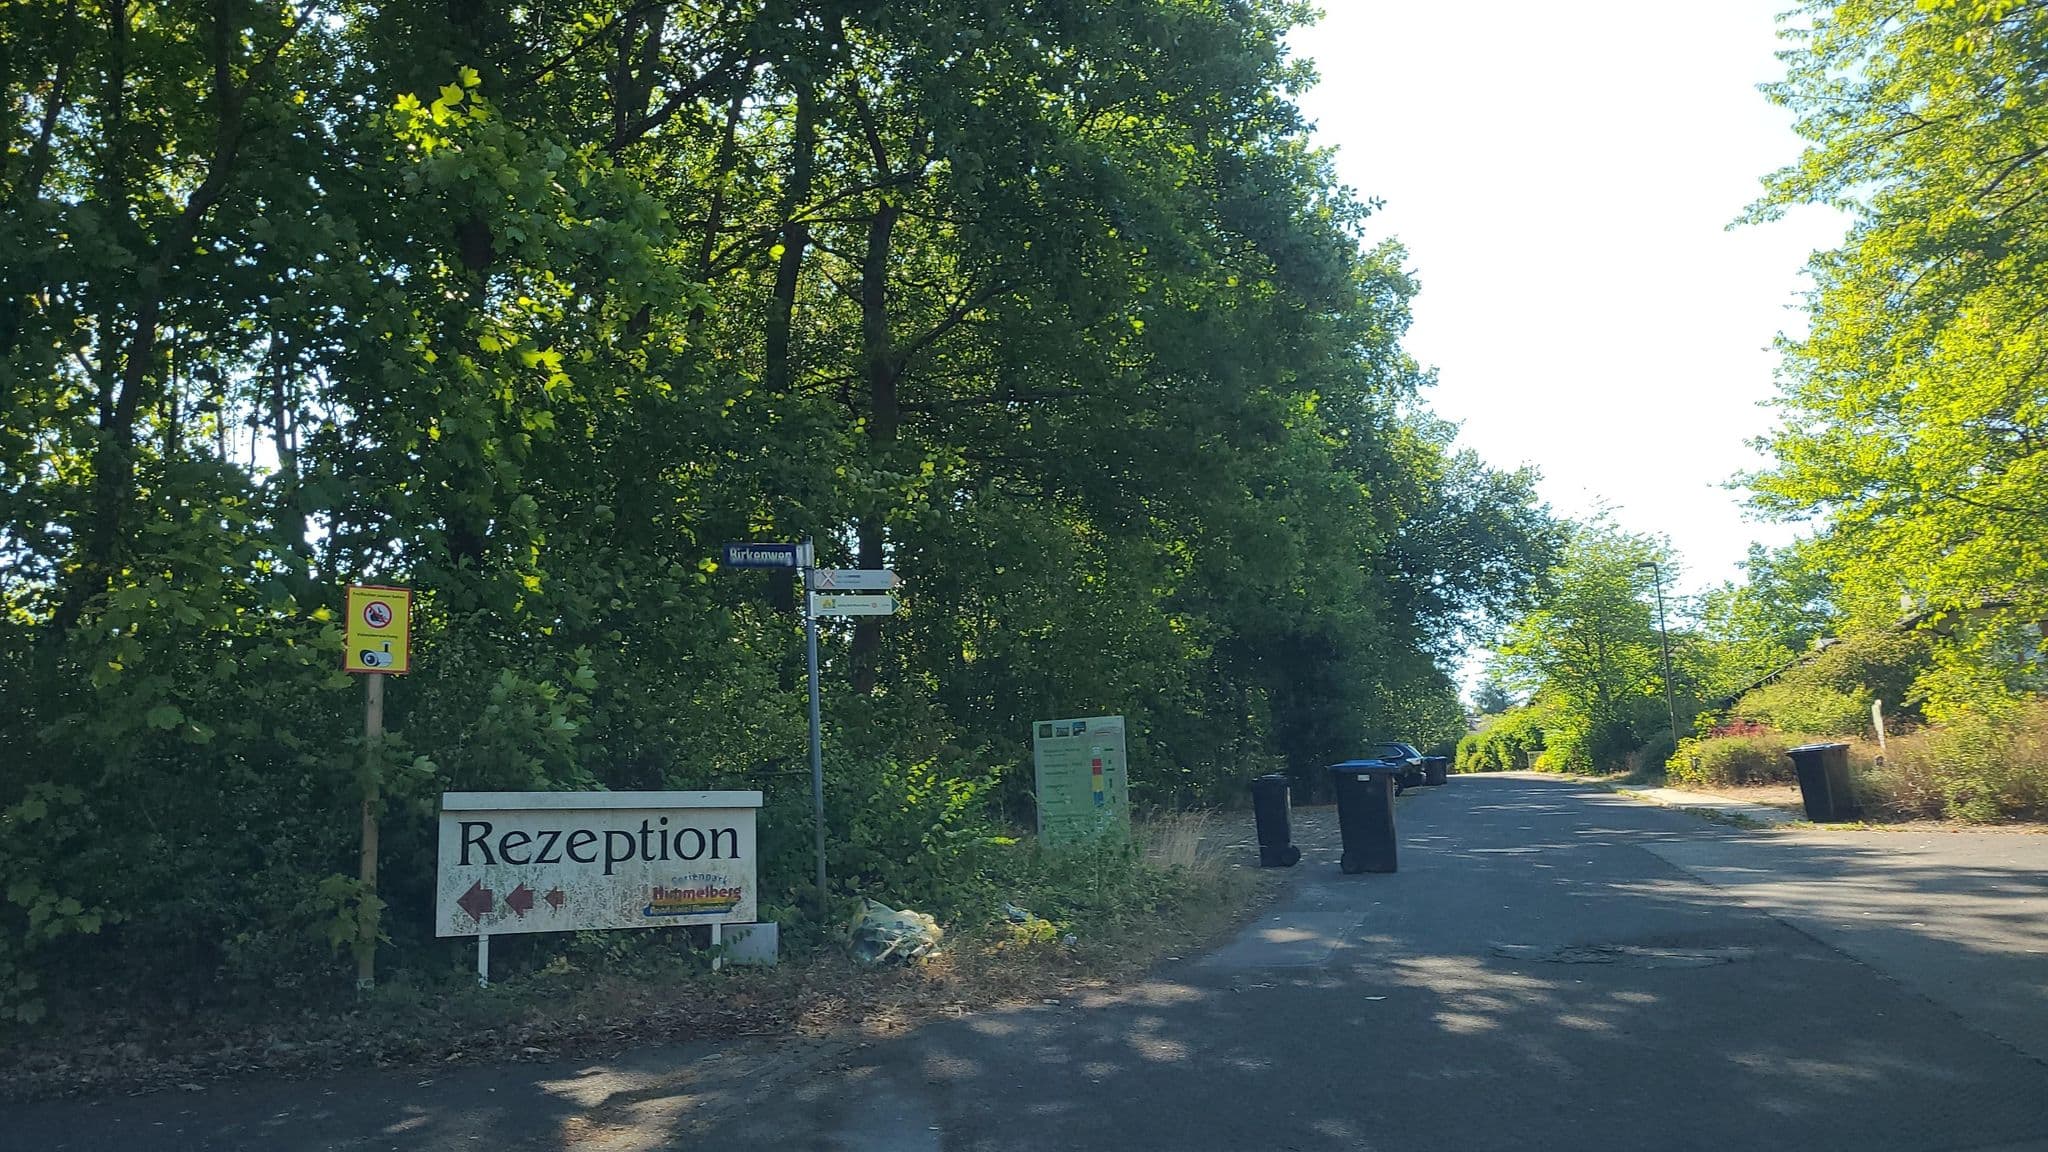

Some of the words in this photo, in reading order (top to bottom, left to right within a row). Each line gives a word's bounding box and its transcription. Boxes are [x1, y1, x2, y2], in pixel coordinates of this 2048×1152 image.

[729, 547, 792, 566] Birkenweg
[457, 816, 740, 875] Rezeption
[653, 884, 742, 902] Himmelberg
